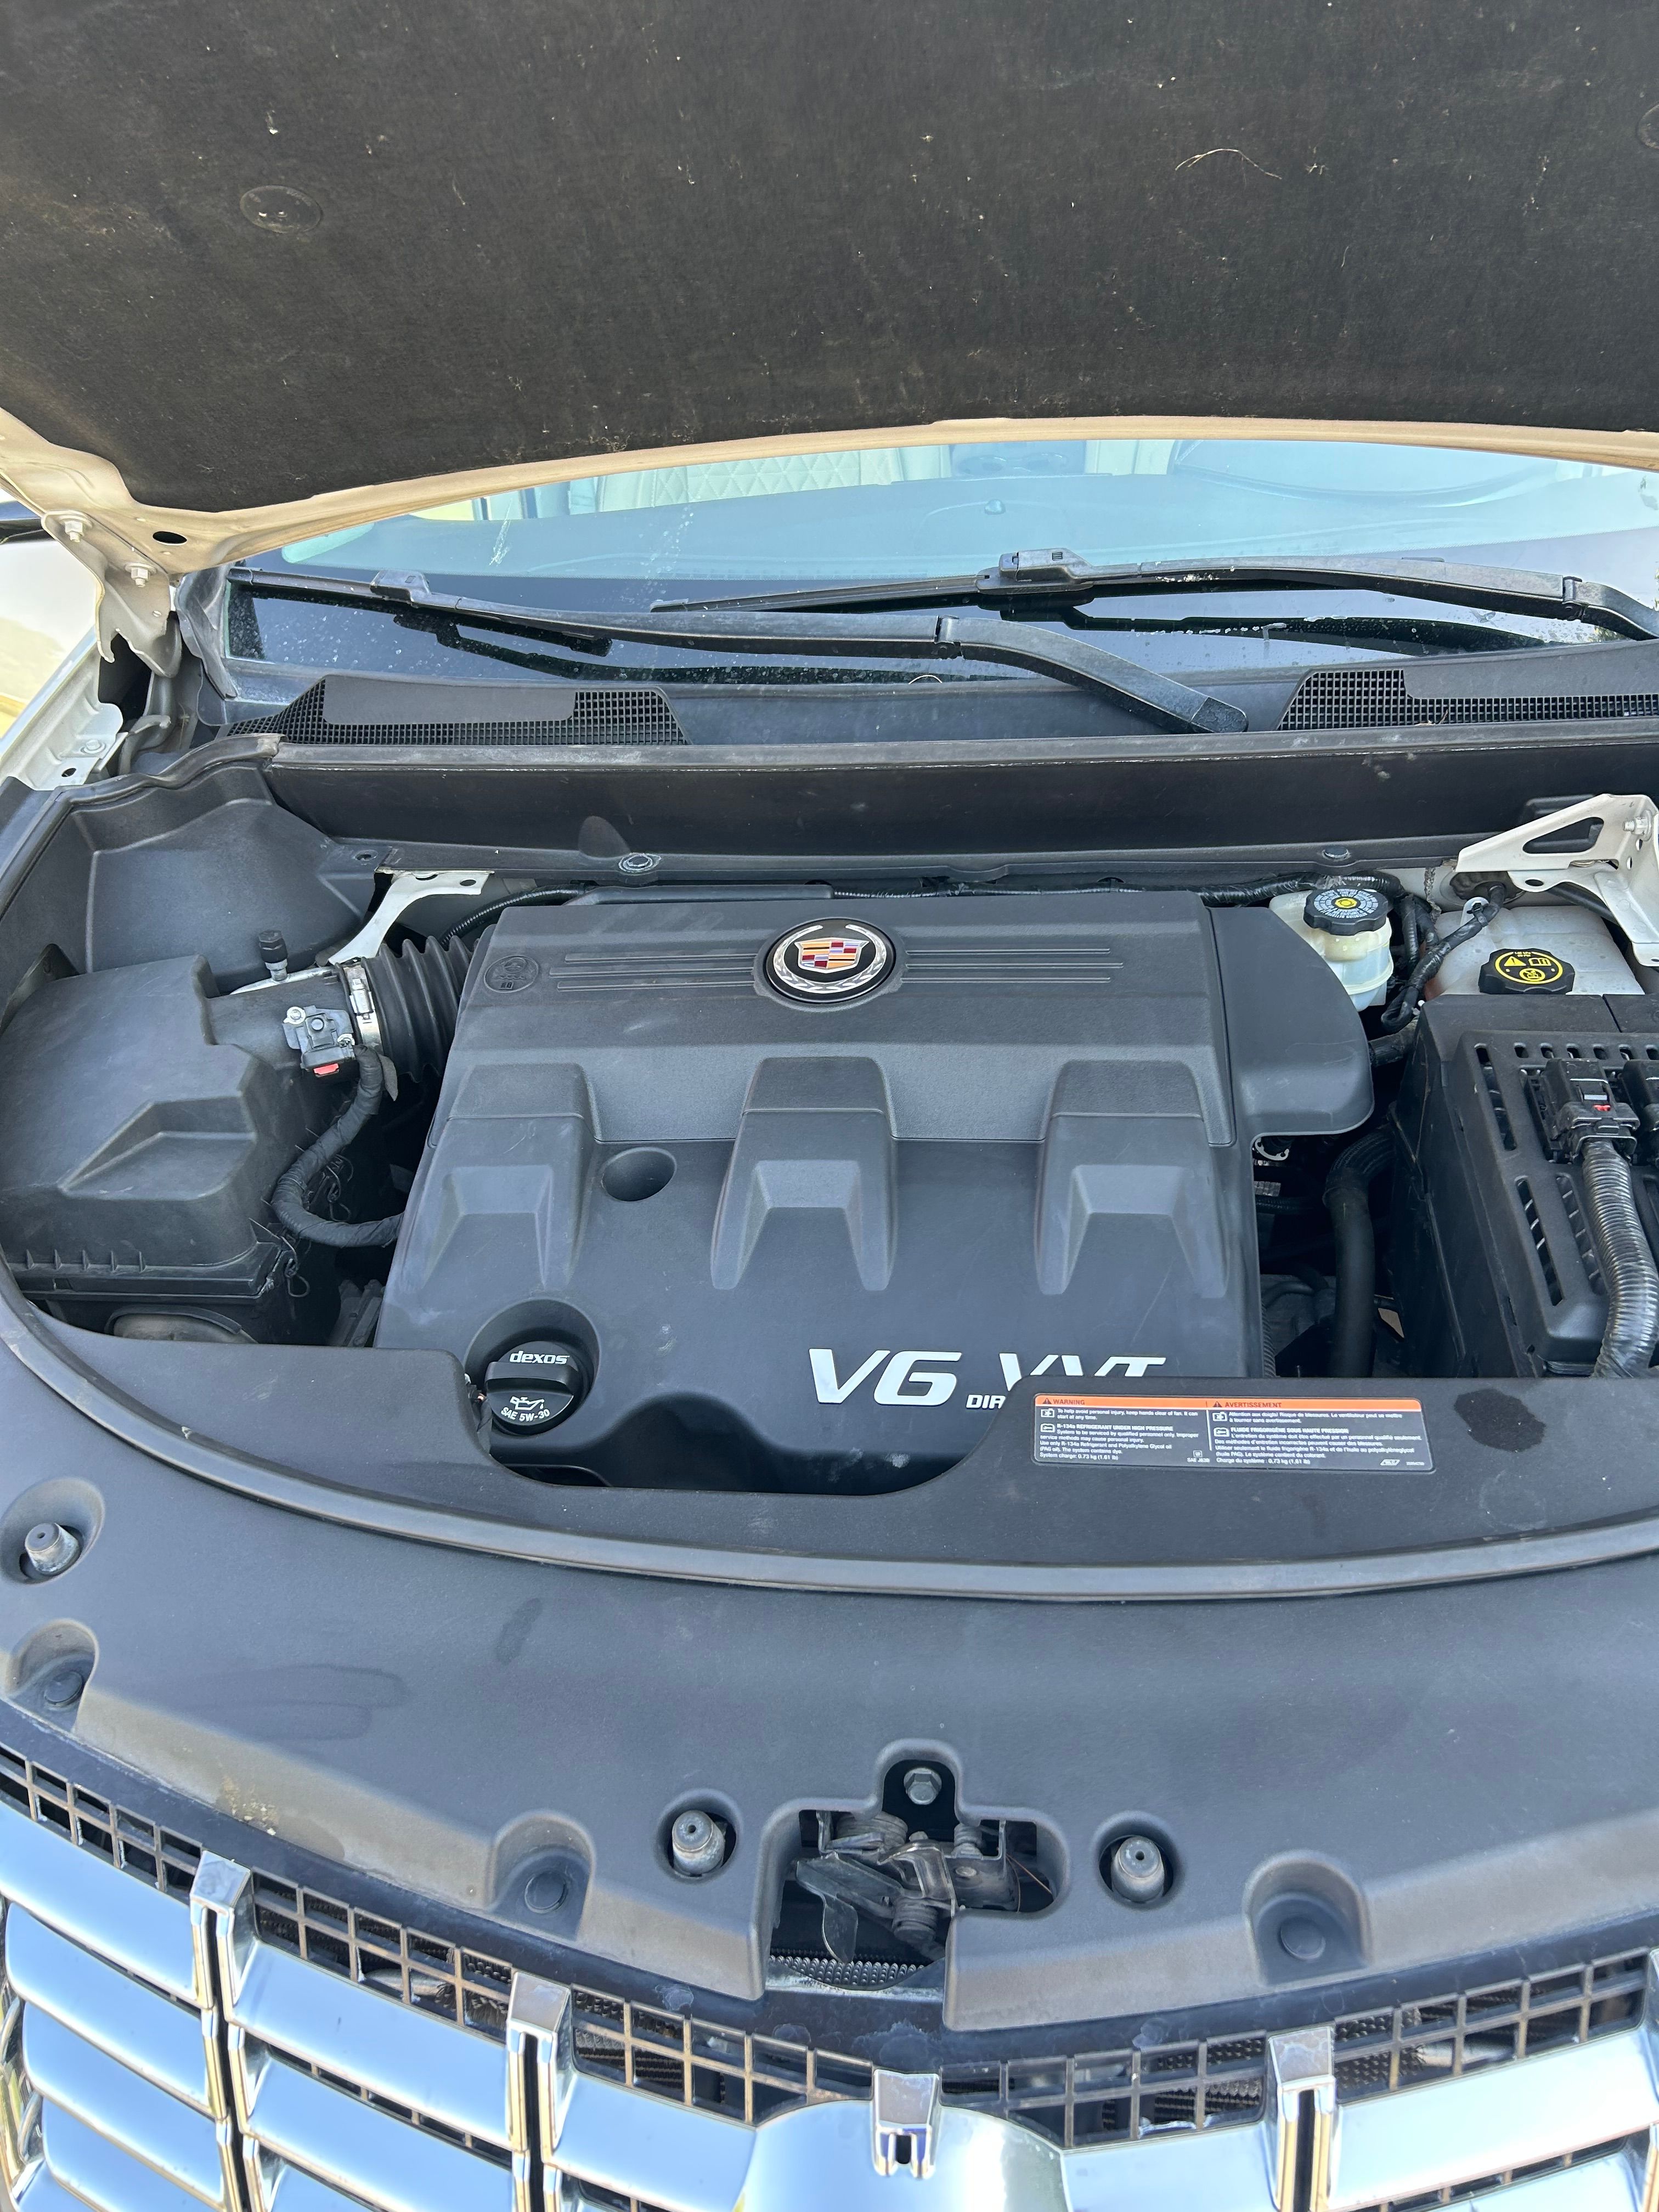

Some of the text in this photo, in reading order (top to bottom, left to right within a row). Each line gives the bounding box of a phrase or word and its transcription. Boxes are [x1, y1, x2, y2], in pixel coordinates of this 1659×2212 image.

[510, 1351, 568, 1364] dexos
[809, 1348, 962, 1406] V6
[501, 1407, 550, 1421] SAE 5W-30
